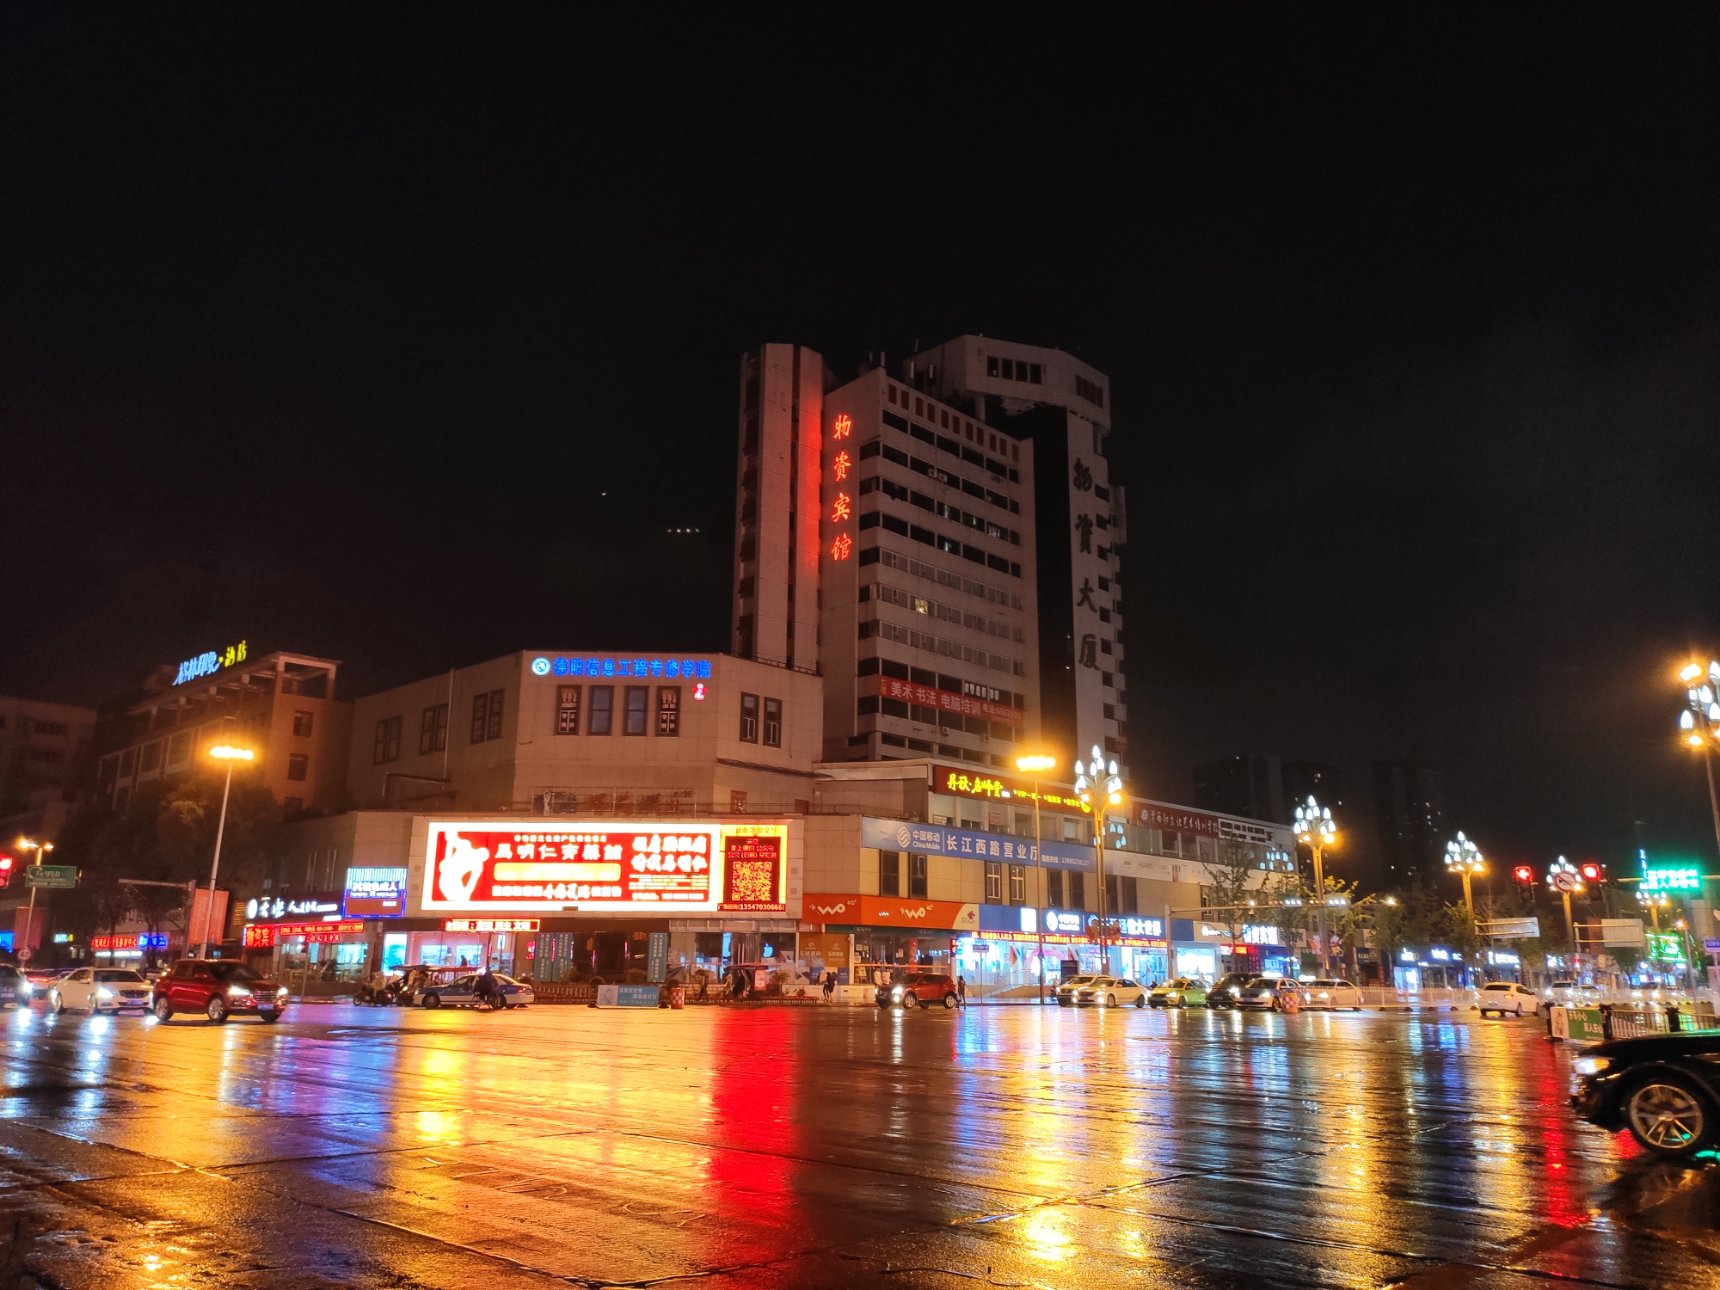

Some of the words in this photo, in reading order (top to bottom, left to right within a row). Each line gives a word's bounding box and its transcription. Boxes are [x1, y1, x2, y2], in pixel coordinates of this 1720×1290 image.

[830, 414, 853, 562] 物资宾馆
[553, 657, 711, 679] 德阳信息工程专修学院
[891, 682, 913, 698] 美术
[916, 687, 937, 705] 书法
[941, 693, 981, 716] 电脑培训
[912, 830, 940, 843] 中国移动
[946, 834, 1038, 861] 长江西路营业厅
